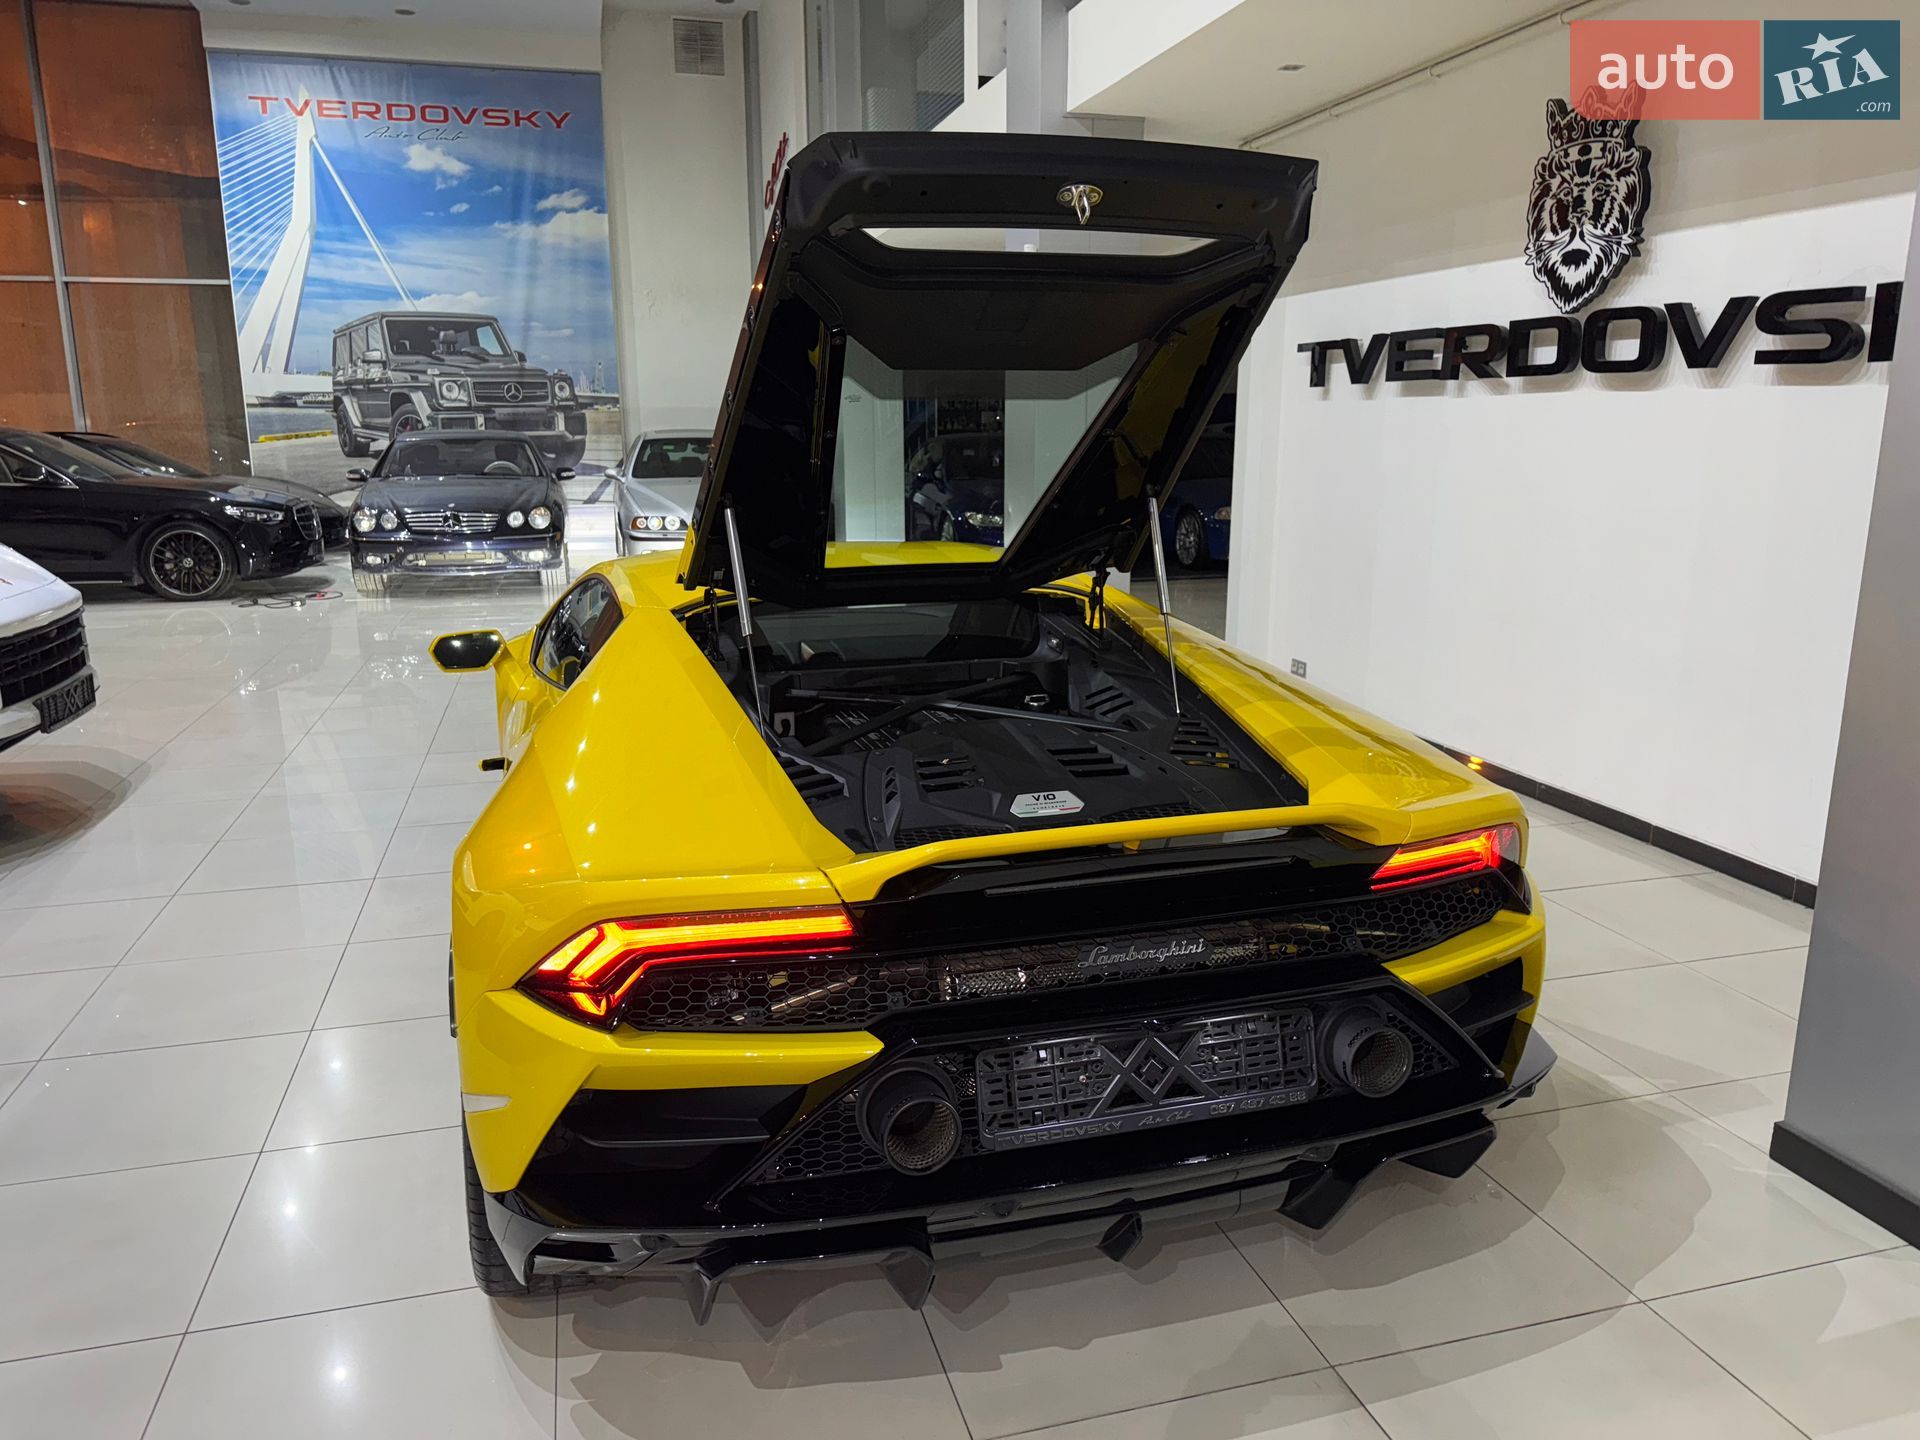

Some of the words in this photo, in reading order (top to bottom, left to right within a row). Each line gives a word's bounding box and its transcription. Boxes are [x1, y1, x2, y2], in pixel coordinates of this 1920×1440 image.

[247, 95, 572, 129] TVERDOVSKY
[364, 125, 414, 142] Auto
[417, 127, 470, 142] Club
[1077, 937, 1206, 968] Lamborghini
[997, 1119, 1123, 1148] TVERDOVSKY
